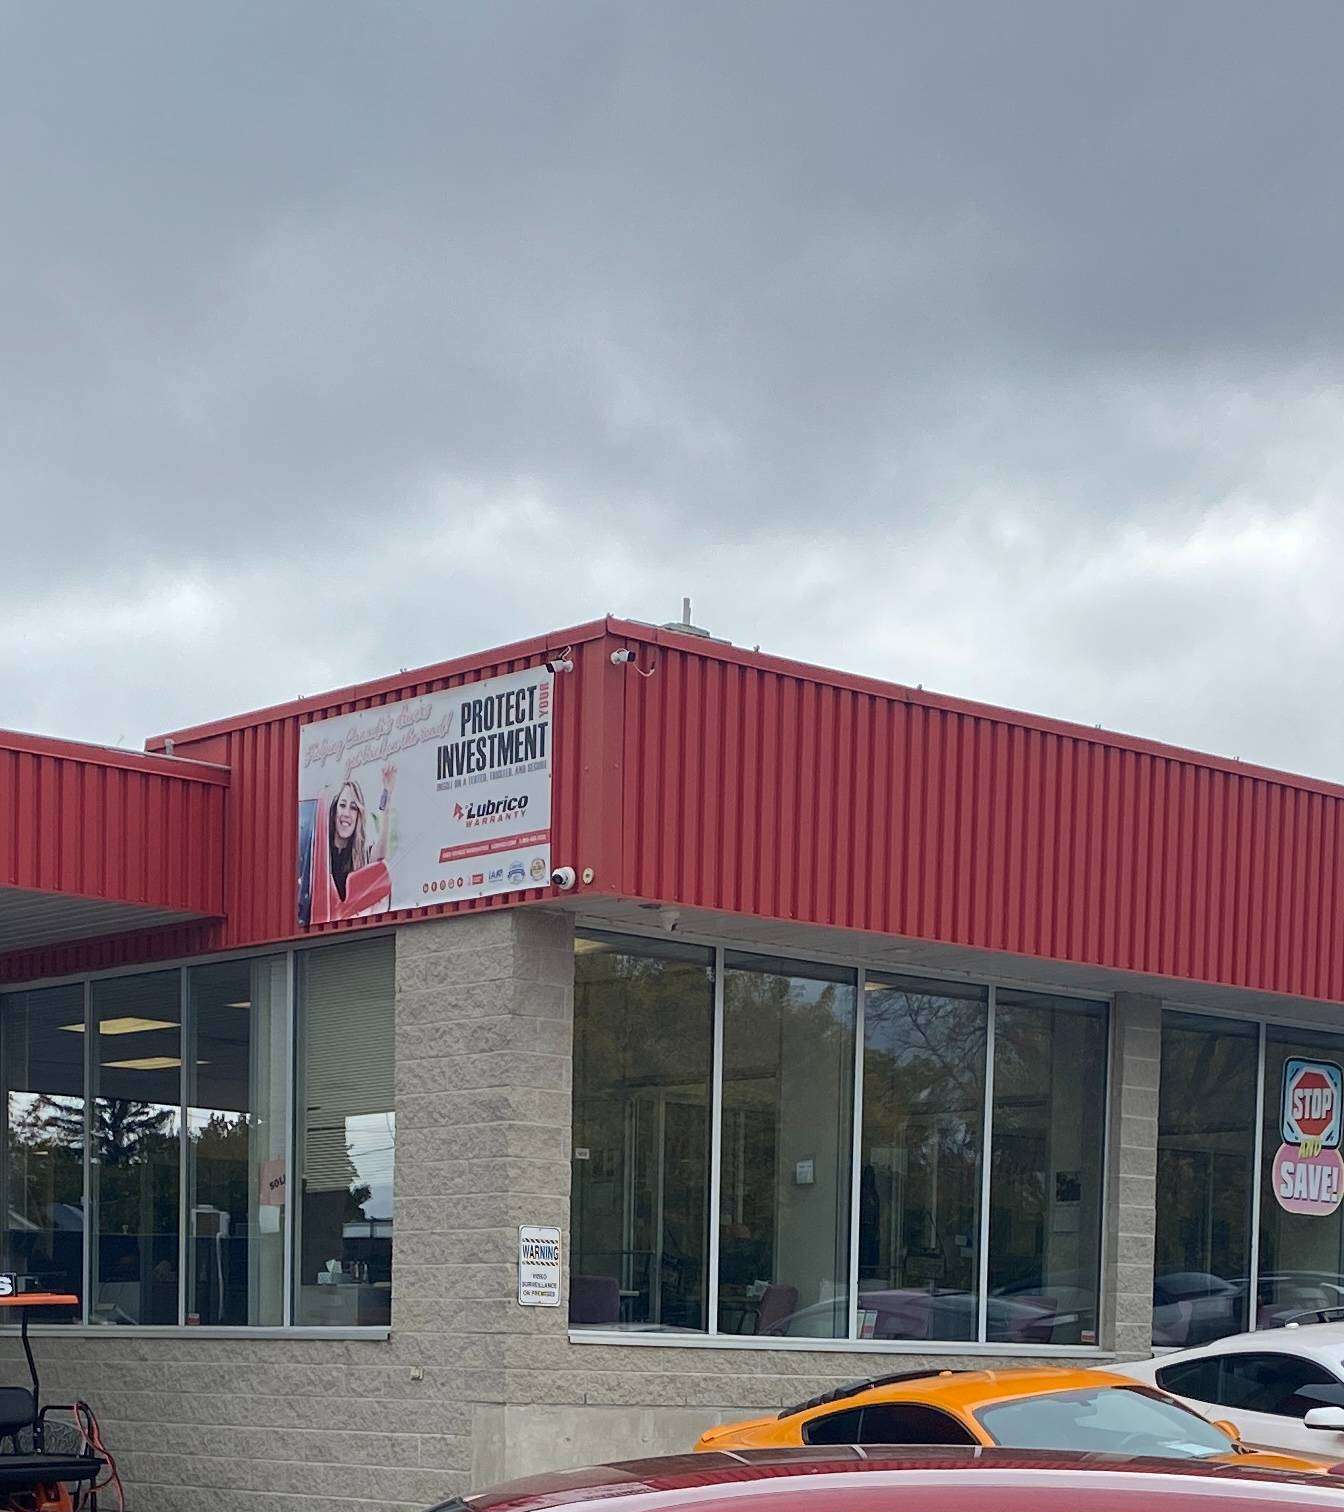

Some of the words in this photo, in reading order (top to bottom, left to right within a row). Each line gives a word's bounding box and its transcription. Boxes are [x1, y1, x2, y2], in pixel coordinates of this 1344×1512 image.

[460, 685, 537, 737] PROTECT
[539, 682, 549, 718] YOUR
[436, 721, 548, 780] INVESTMENT
[466, 795, 529, 819] Lubrico
[466, 809, 527, 828] WARRANTY
[1292, 1087, 1333, 1121] STOP
[1298, 1137, 1322, 1160] AND
[269, 1173, 286, 1190] SOL
[1280, 1160, 1339, 1203] SAVE!
[522, 1245, 558, 1260] WARNING
